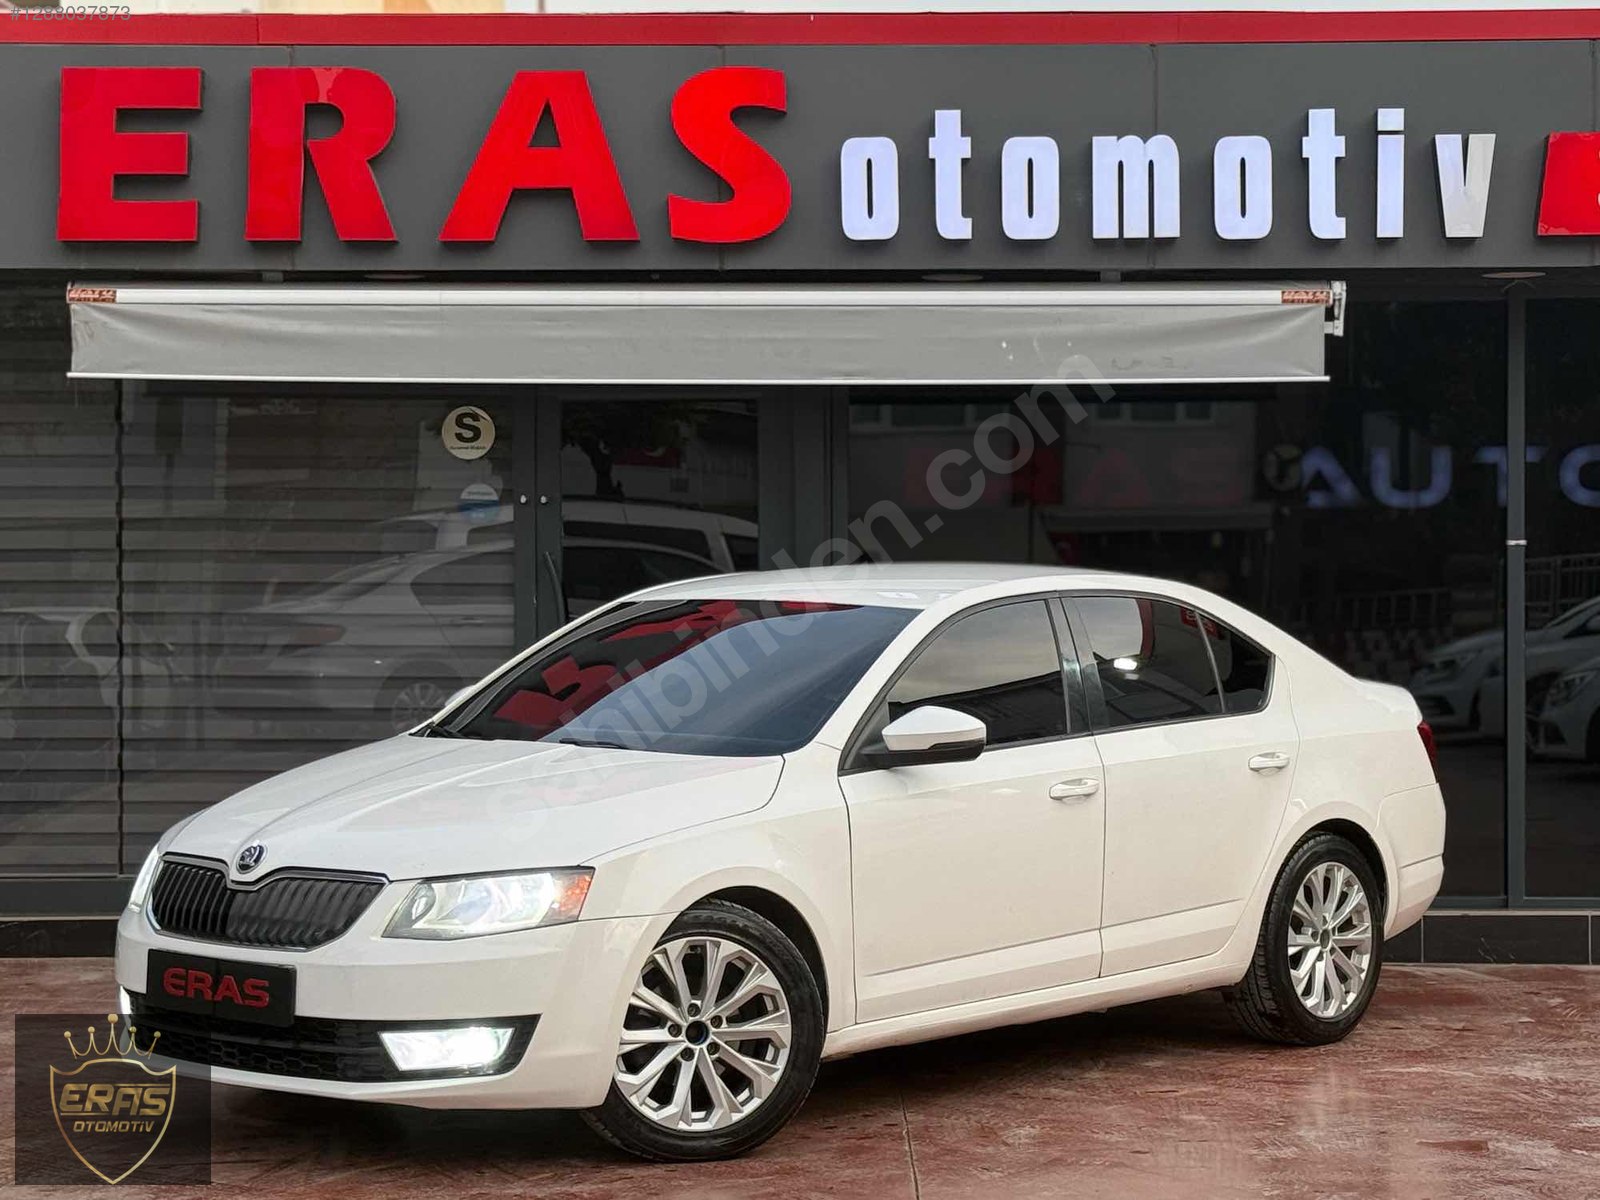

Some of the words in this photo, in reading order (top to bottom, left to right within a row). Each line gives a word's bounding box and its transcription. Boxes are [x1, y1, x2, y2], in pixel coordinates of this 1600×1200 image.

[57, 66, 792, 243] ERAS
[840, 107, 1496, 241] otomotiv
[454, 411, 482, 444] S
[163, 966, 270, 1009] ERAS
